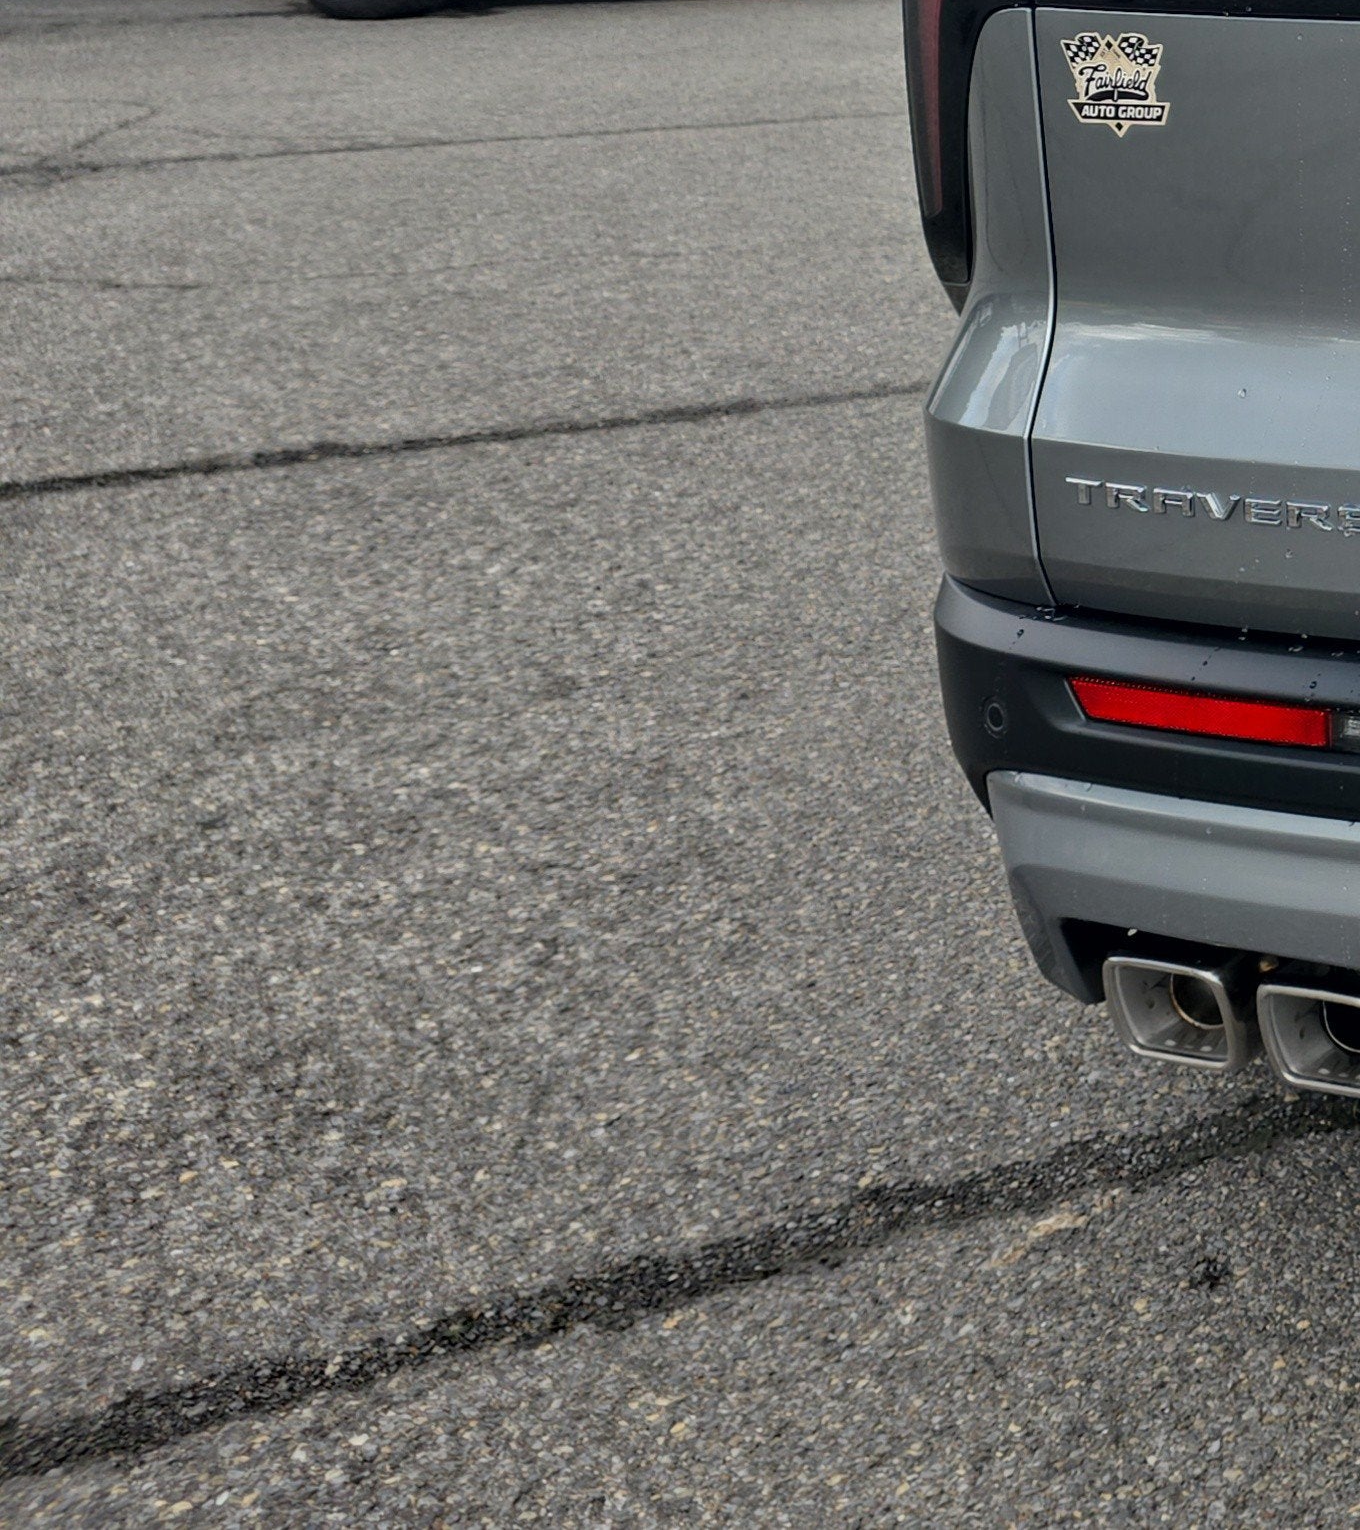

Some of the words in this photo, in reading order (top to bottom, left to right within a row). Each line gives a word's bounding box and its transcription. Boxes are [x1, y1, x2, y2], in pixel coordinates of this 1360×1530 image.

[1078, 64, 1152, 97] Fairfield
[1081, 105, 1115, 117] AUTO
[1118, 106, 1161, 119] GROUP
